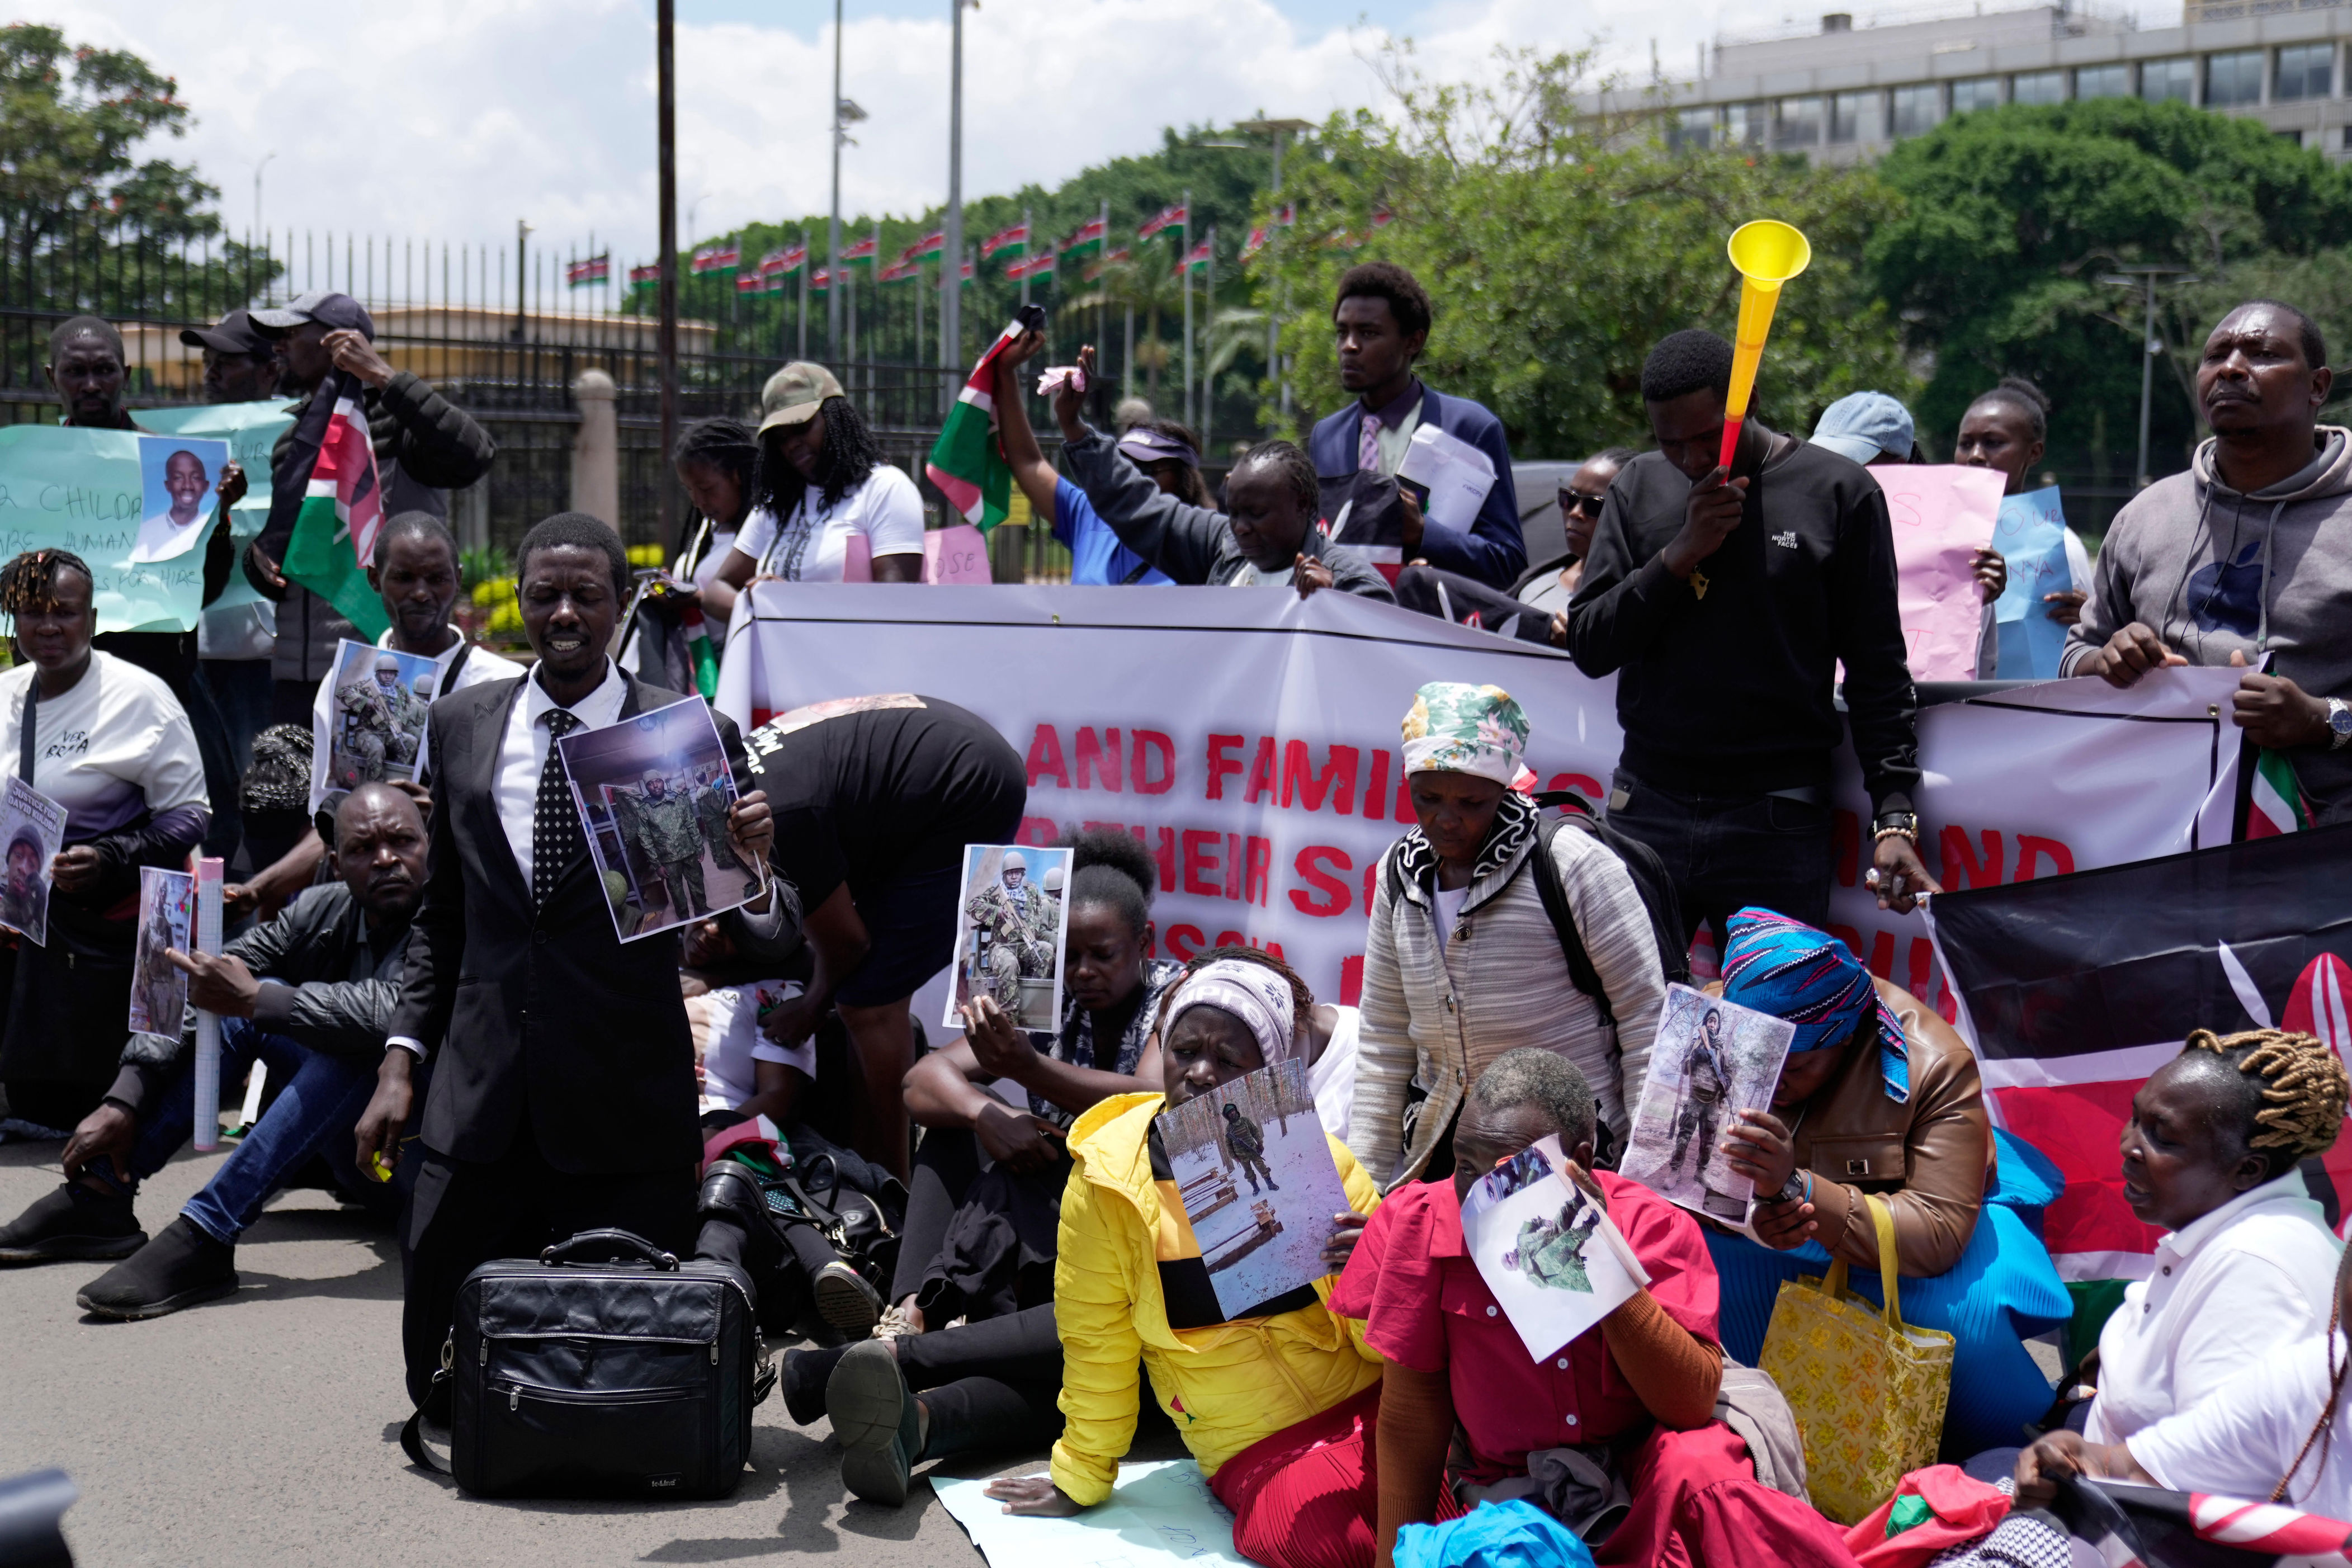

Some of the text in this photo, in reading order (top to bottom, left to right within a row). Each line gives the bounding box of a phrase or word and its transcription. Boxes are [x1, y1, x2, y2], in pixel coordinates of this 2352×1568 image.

[1025, 724, 1175, 795] AND
[8, 795, 32, 816] DAVID
[12, 787, 57, 823] JUSTICE FOR
